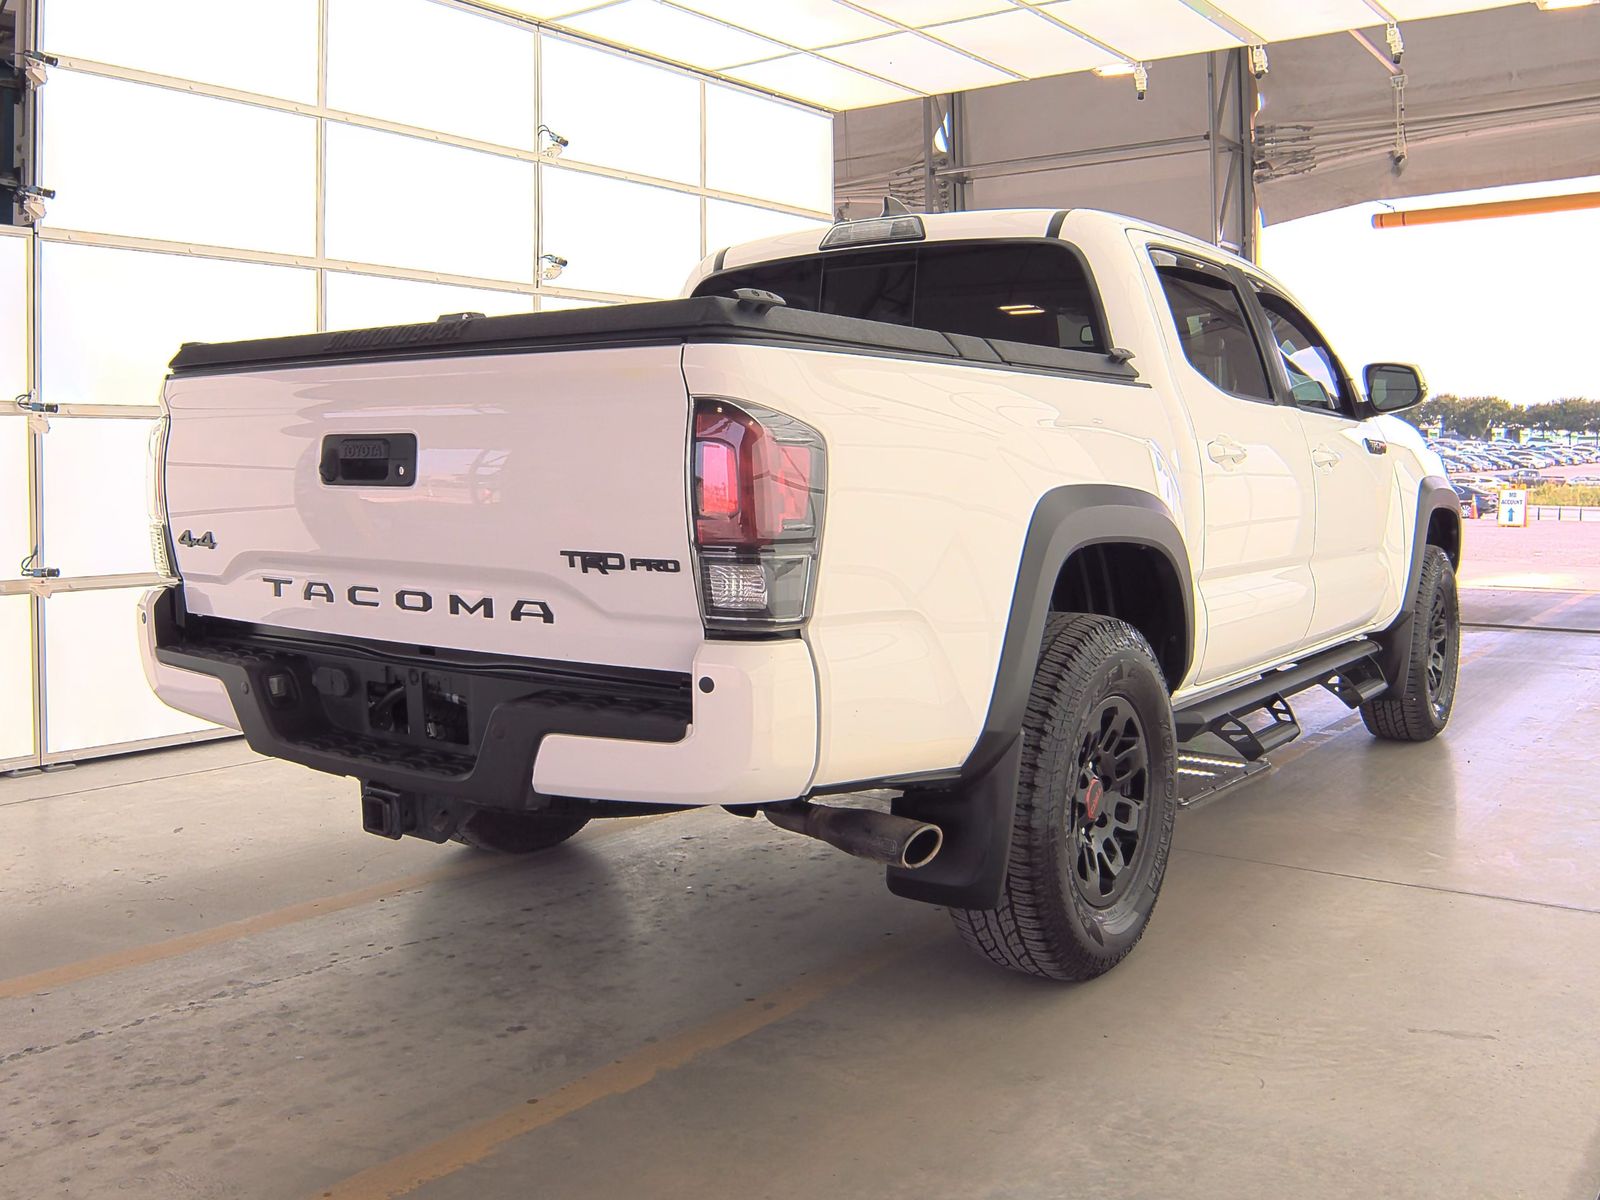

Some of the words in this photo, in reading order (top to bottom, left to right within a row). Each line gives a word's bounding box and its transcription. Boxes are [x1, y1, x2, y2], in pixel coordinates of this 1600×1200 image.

[341, 444, 384, 457] TOYOTA
[560, 550, 625, 575] TRD
[630, 558, 680, 572] PRO
[262, 577, 555, 625] TACOMA
